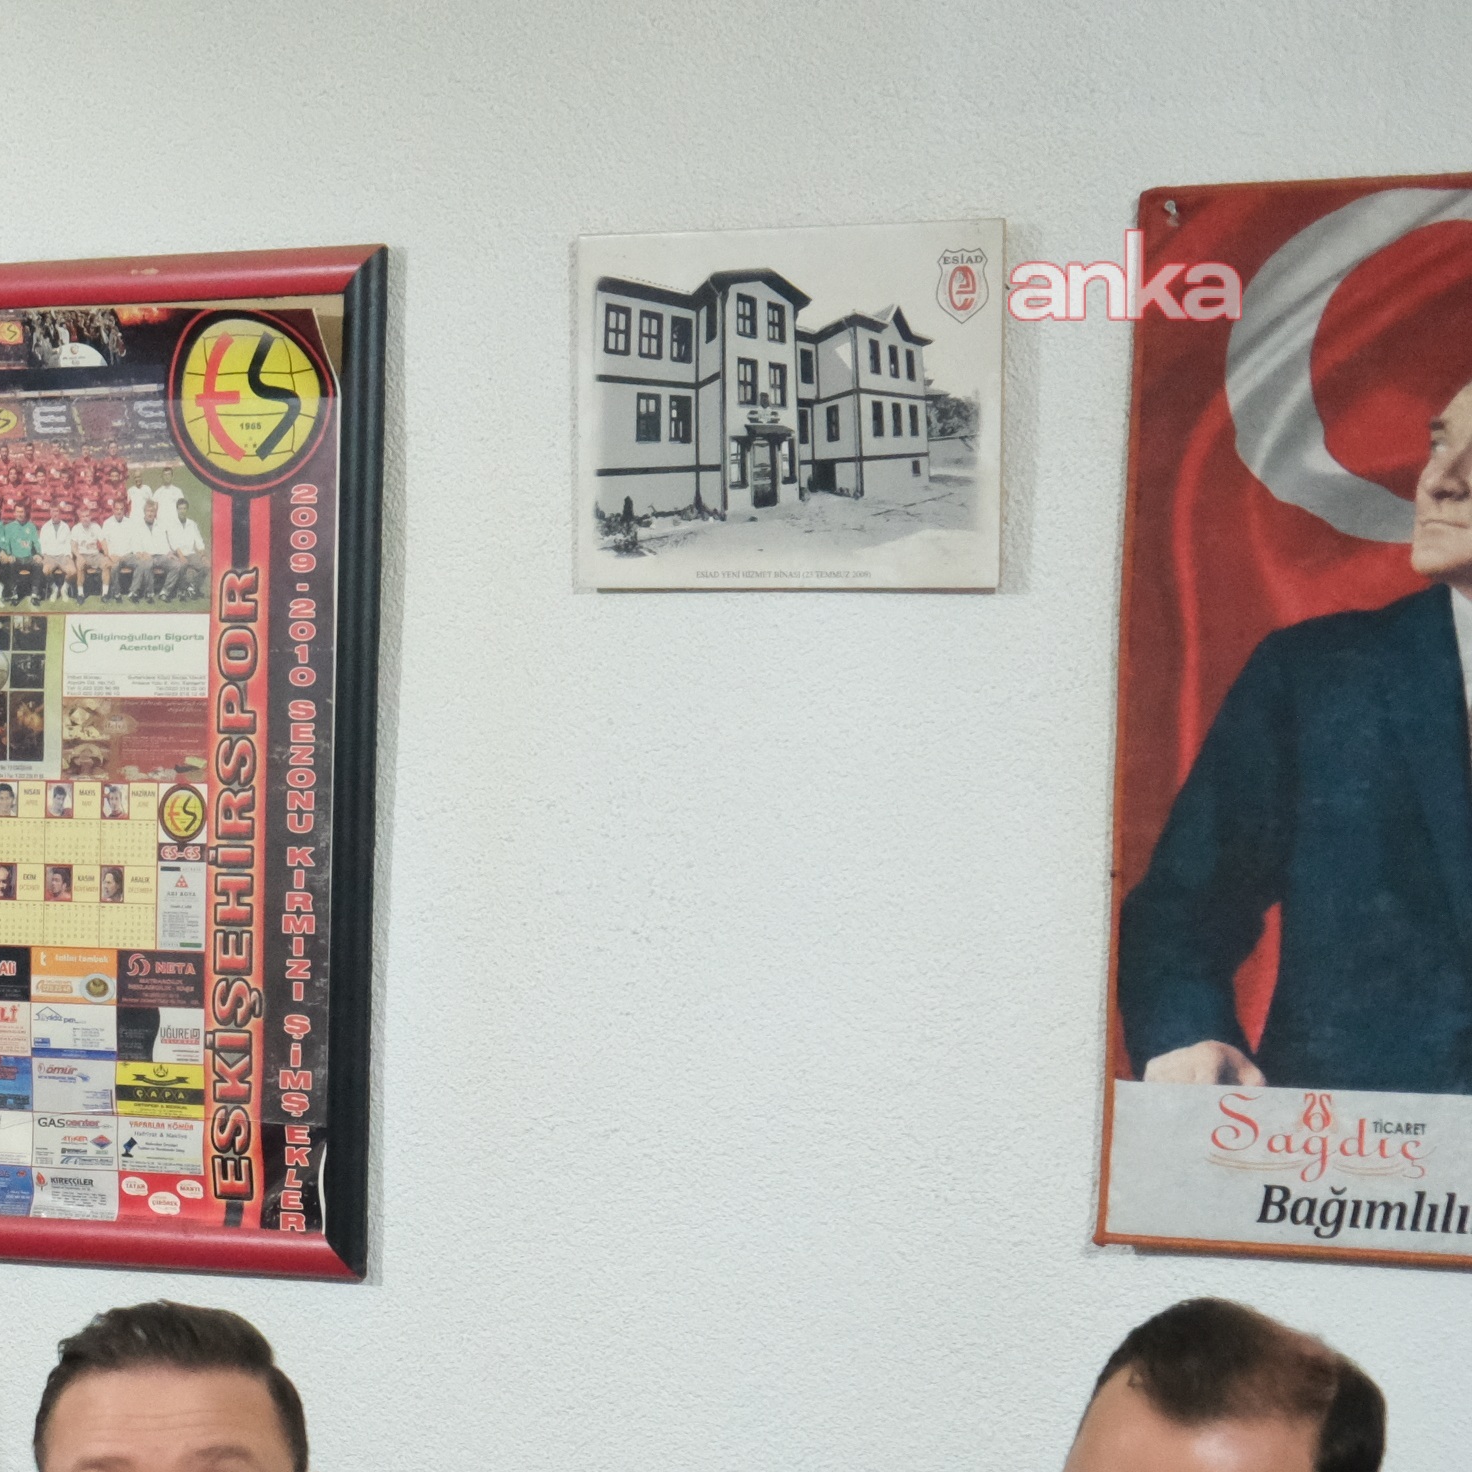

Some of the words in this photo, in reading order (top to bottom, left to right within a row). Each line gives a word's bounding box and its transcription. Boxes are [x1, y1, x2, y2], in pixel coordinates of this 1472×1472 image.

[286, 700, 316, 834] SEZONU
[205, 566, 262, 1202] ESKİŞEHİRSPOR
[282, 846, 316, 1002] KIRMIZI
[278, 1013, 313, 1232] ŞİMŞEKLER
[1373, 1119, 1427, 1136] TİCARET
[1256, 1184, 1472, 1239] Bağımlılı
